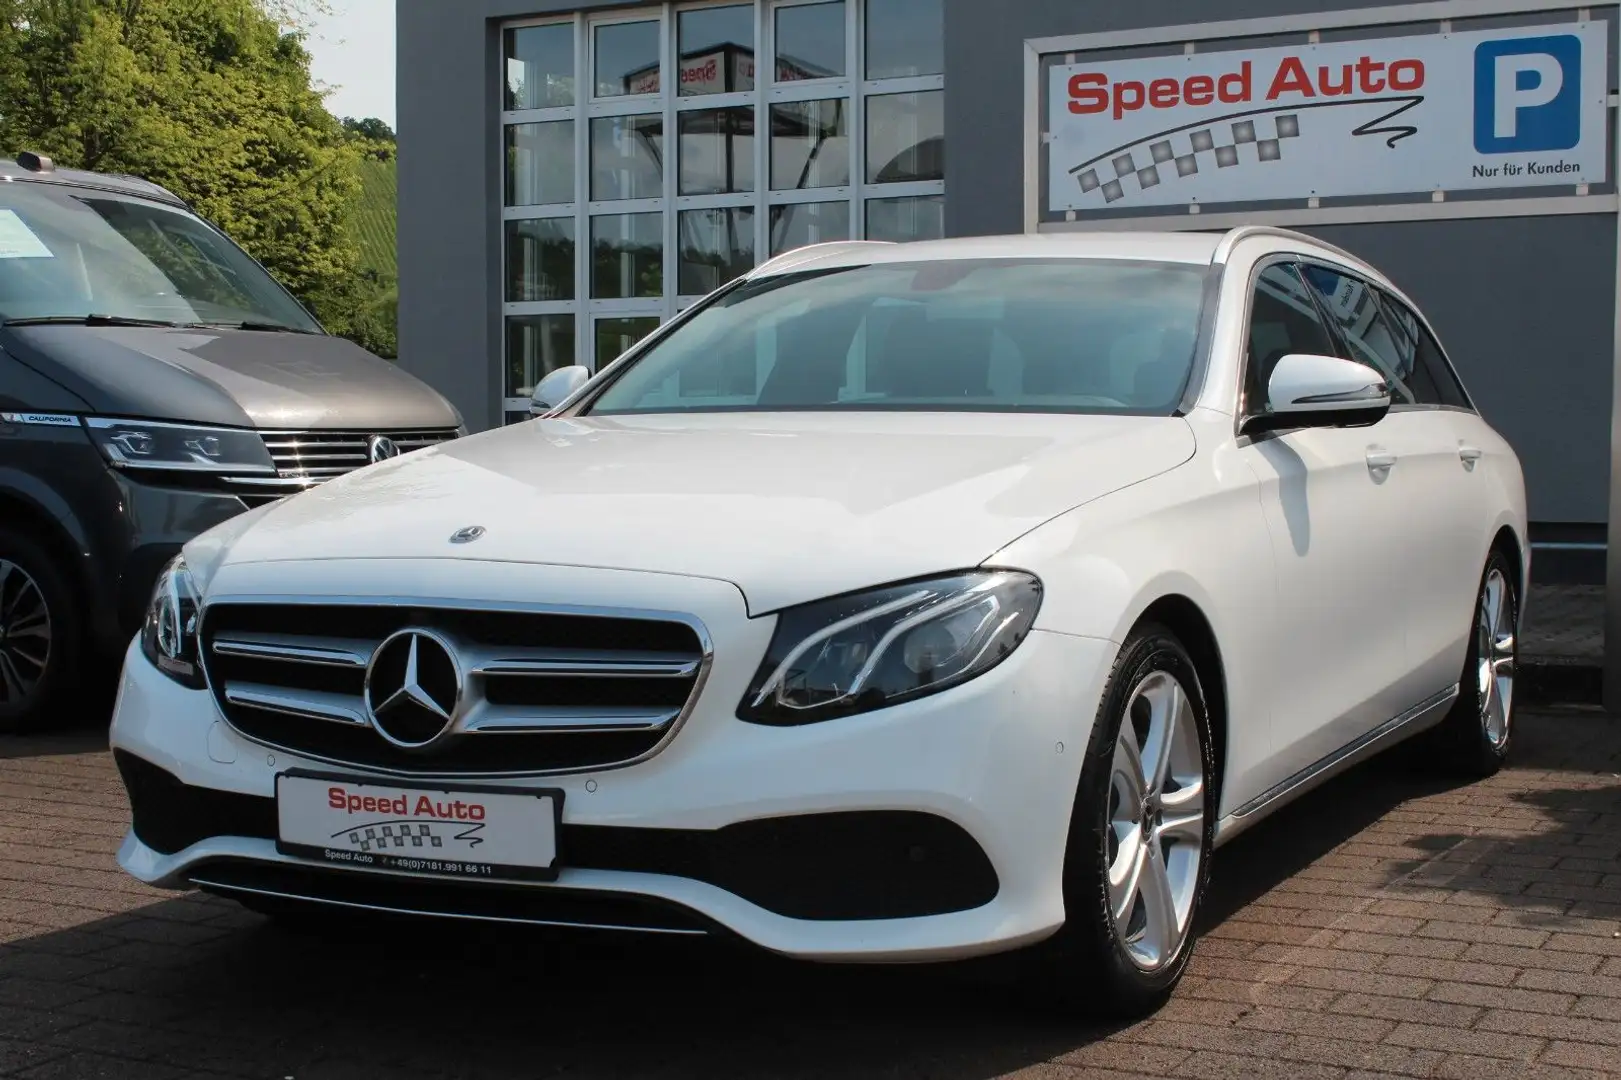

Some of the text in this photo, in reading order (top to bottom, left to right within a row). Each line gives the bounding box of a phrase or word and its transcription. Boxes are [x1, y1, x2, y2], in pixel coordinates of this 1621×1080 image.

[1067, 57, 1425, 119] Speed Auto
[1494, 52, 1563, 139] P
[1472, 160, 1580, 178] Nur für Kunden
[328, 788, 486, 820] Speed Auto
[324, 849, 373, 864] Speed Auto
[465, 864, 478, 874] 66
[480, 865, 492, 874] 11
